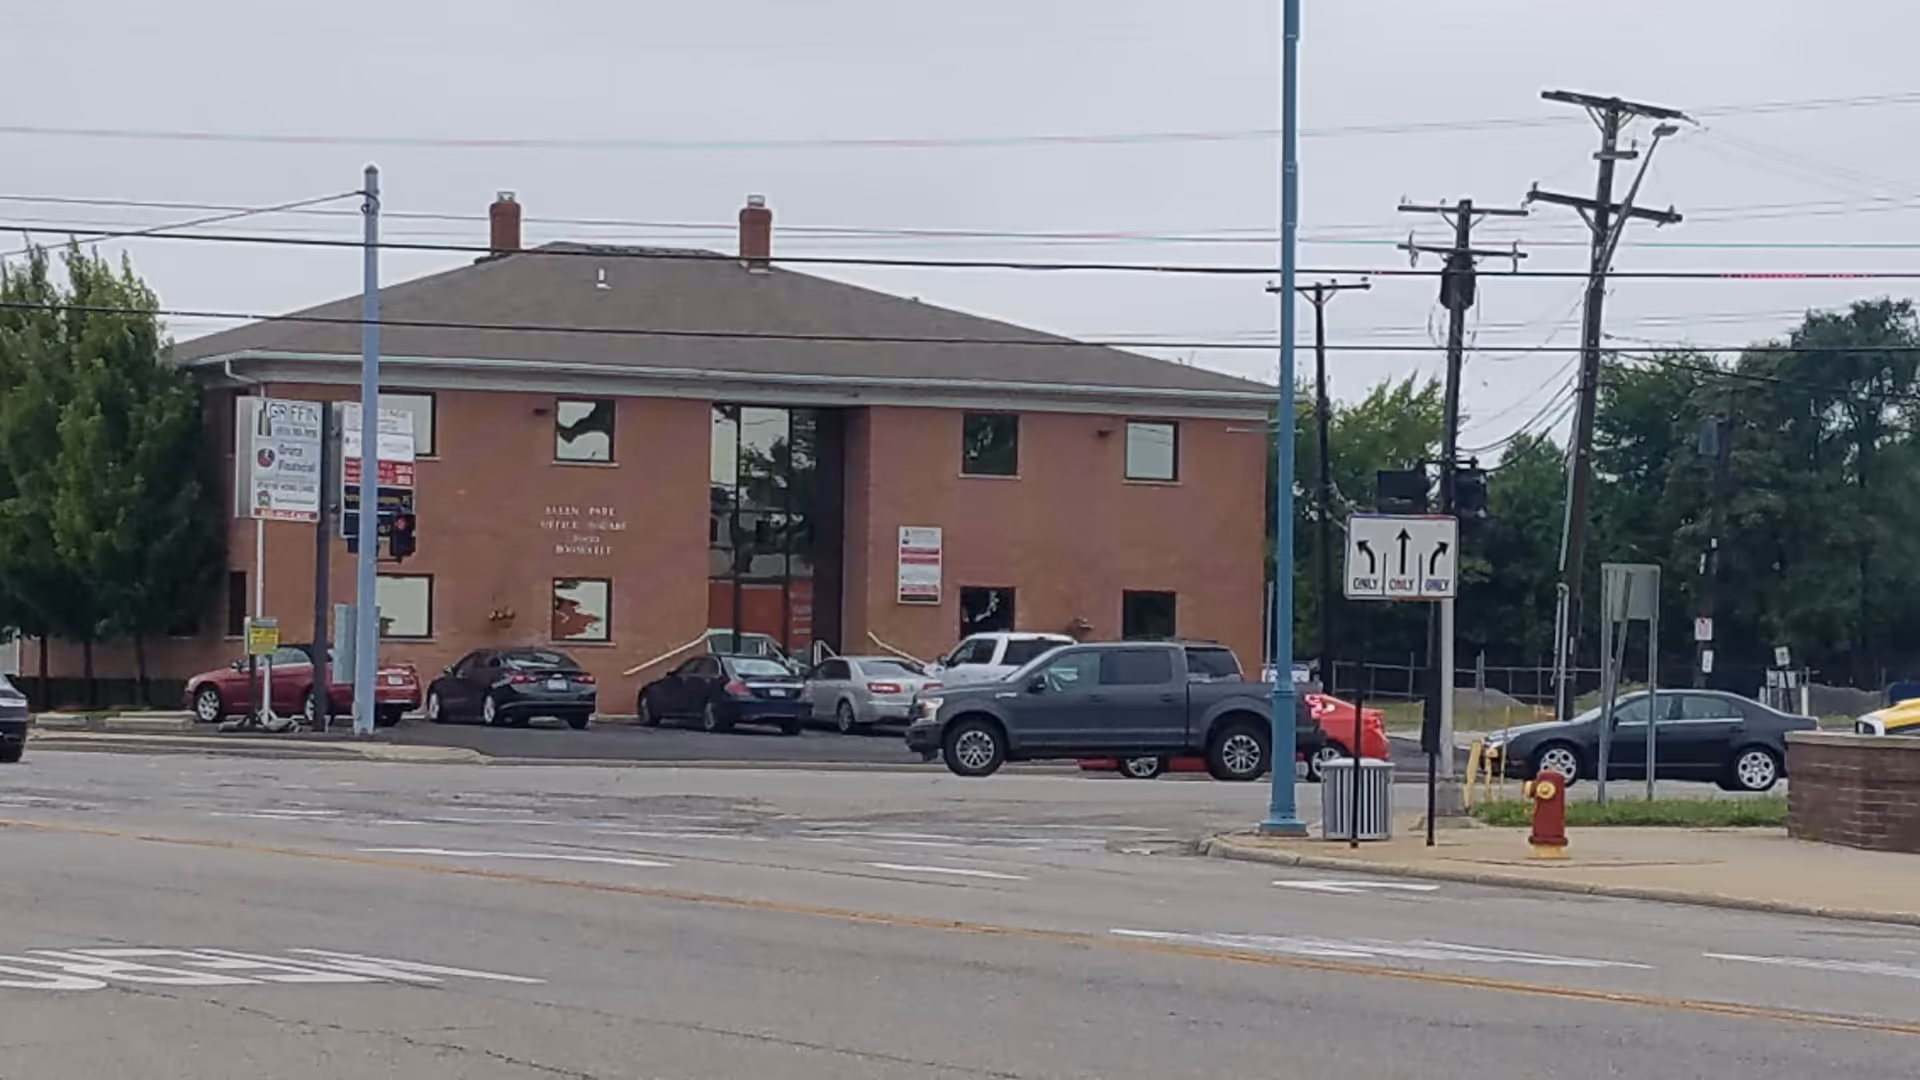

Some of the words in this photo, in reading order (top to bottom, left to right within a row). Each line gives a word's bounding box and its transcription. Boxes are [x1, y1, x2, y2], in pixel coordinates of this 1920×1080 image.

[1353, 577, 1378, 591] ONLY
[1388, 578, 1415, 592] ONLY
[1425, 578, 1450, 592] ONLY
